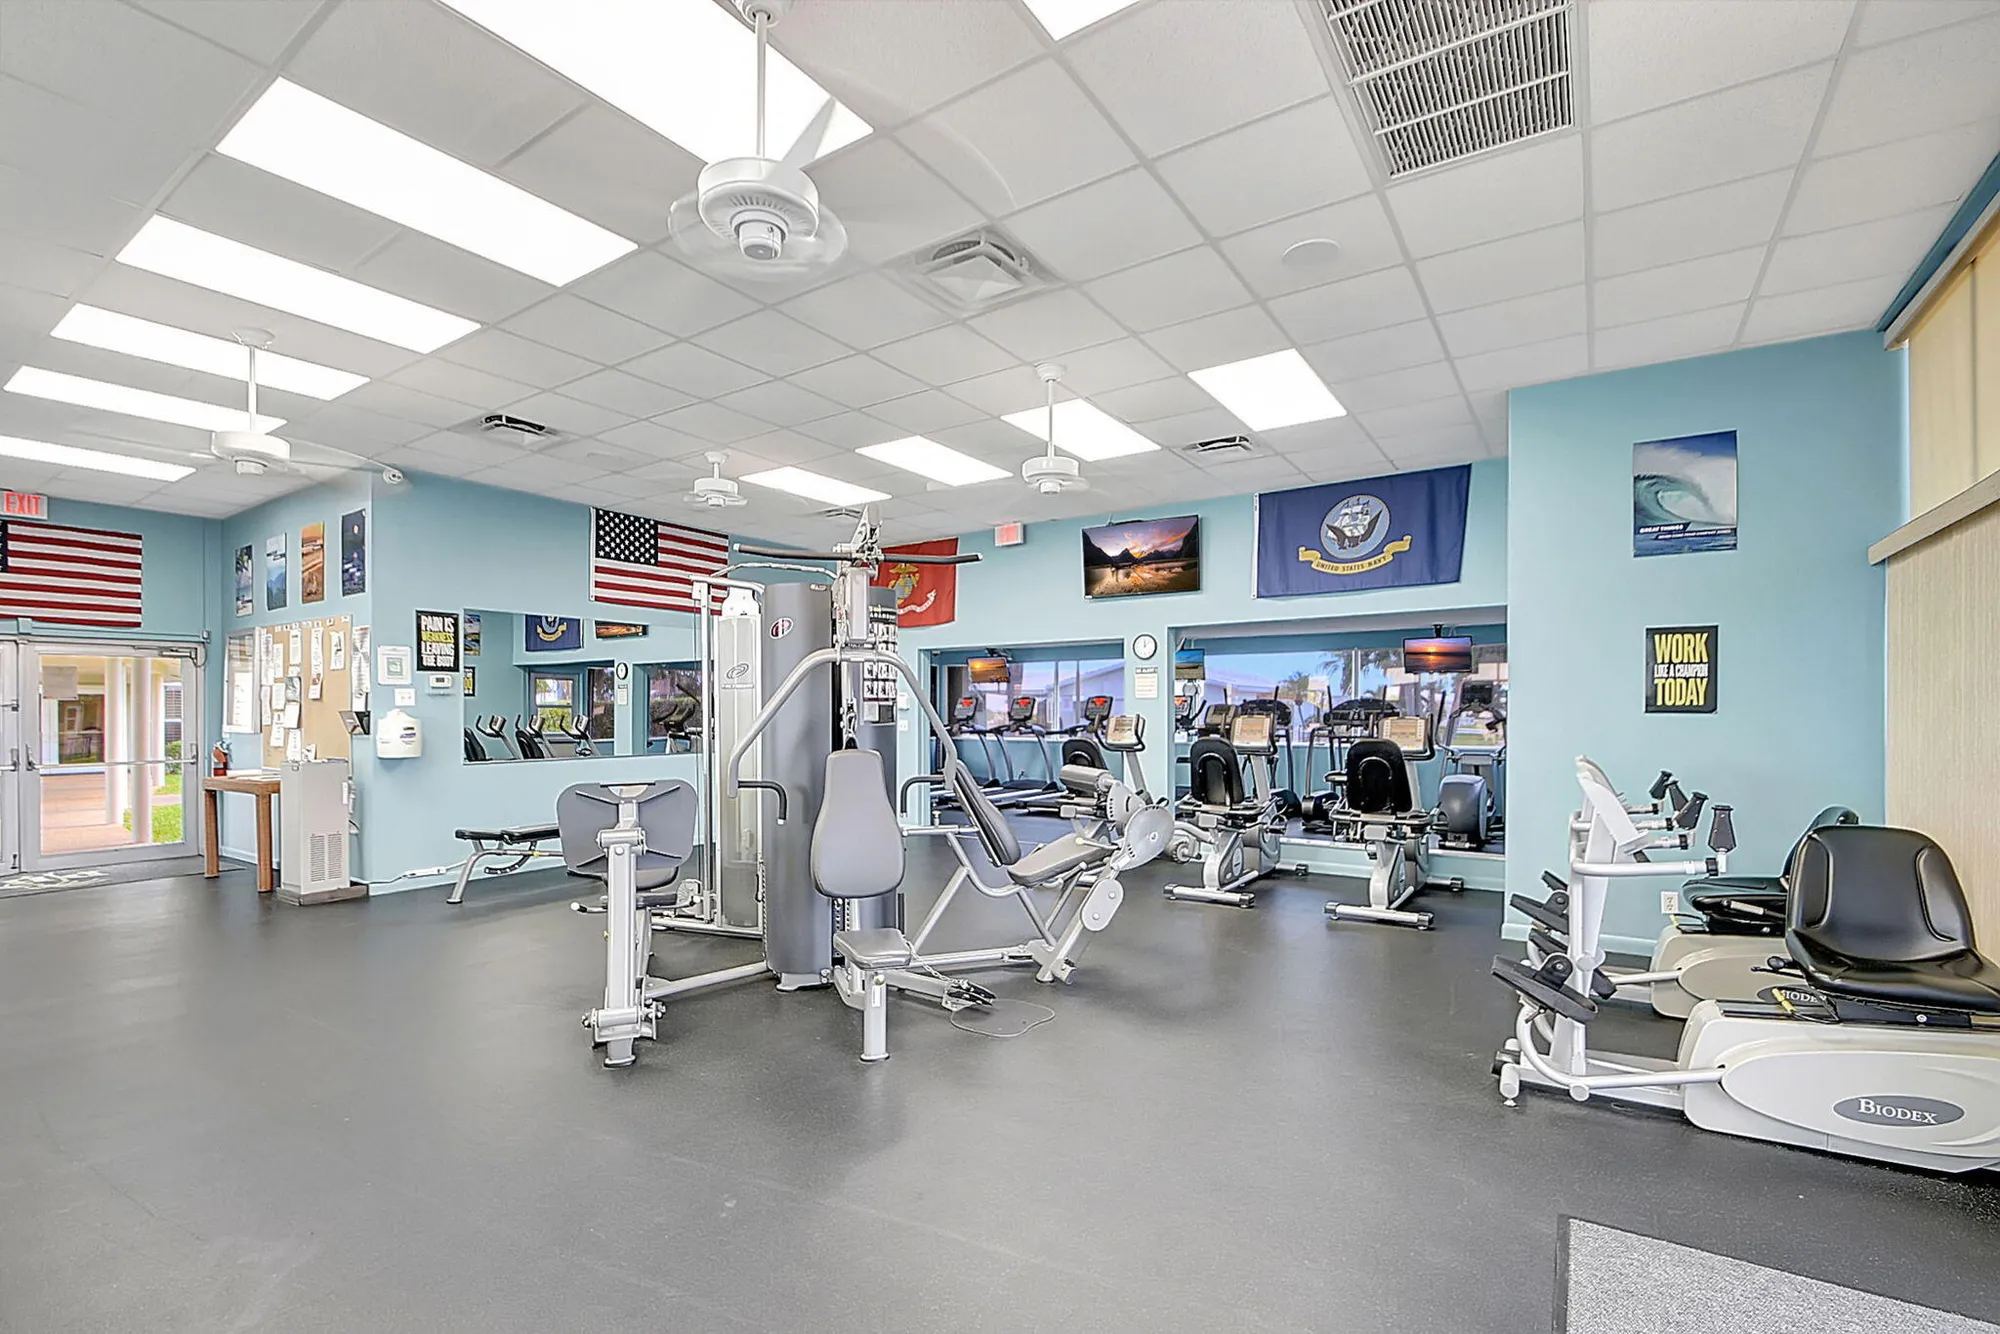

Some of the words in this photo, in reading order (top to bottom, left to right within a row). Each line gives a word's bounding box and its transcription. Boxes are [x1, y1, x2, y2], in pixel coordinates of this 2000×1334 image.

[5, 492, 42, 515] EXIT
[1316, 561, 1339, 572] UNITED
[1342, 563, 1364, 573] STATES
[421, 615, 443, 632] PAIN
[444, 617, 455, 633] IS
[1654, 633, 1709, 663] WORK
[1654, 664, 1669, 678] LIKE
[1669, 664, 1675, 678] A
[1654, 678, 1709, 706] TODAY
